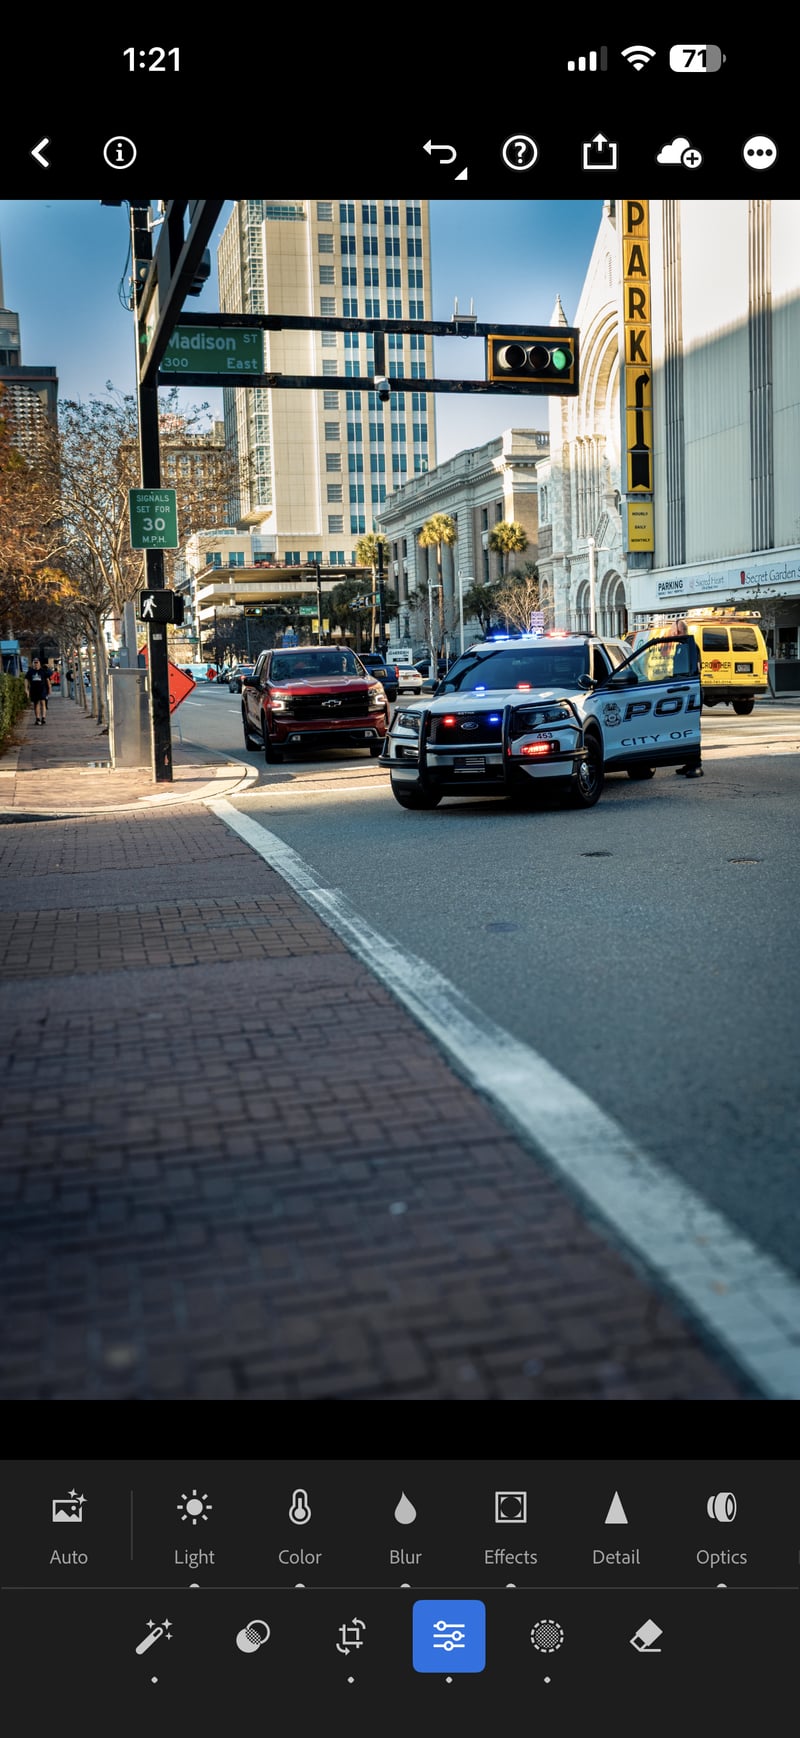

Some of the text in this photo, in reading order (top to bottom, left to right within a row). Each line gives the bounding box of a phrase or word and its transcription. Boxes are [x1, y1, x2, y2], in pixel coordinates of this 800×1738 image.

[123, 46, 181, 72] 1:21
[683, 50, 708, 68] 71
[627, 200, 647, 362] PARK
[243, 334, 258, 344] ST
[164, 357, 258, 370] 300 East
[136, 494, 170, 502] SIGNALS
[136, 505, 171, 513] SET FOR
[142, 517, 166, 532] 30
[142, 535, 167, 543] M.P.H.
[746, 571, 768, 584] Secret
[769, 563, 796, 581] Garden
[657, 580, 684, 591] PARKING
[536, 731, 553, 739] 453
[620, 729, 693, 747] CITY OF
[50, 1549, 89, 1565] Auto
[175, 1548, 215, 1569] Light
[278, 1548, 322, 1565] Color
[390, 1548, 422, 1565] Blur
[484, 1548, 538, 1565] Effects
[592, 1548, 641, 1565] Detail
[696, 1548, 748, 1569] Optics
